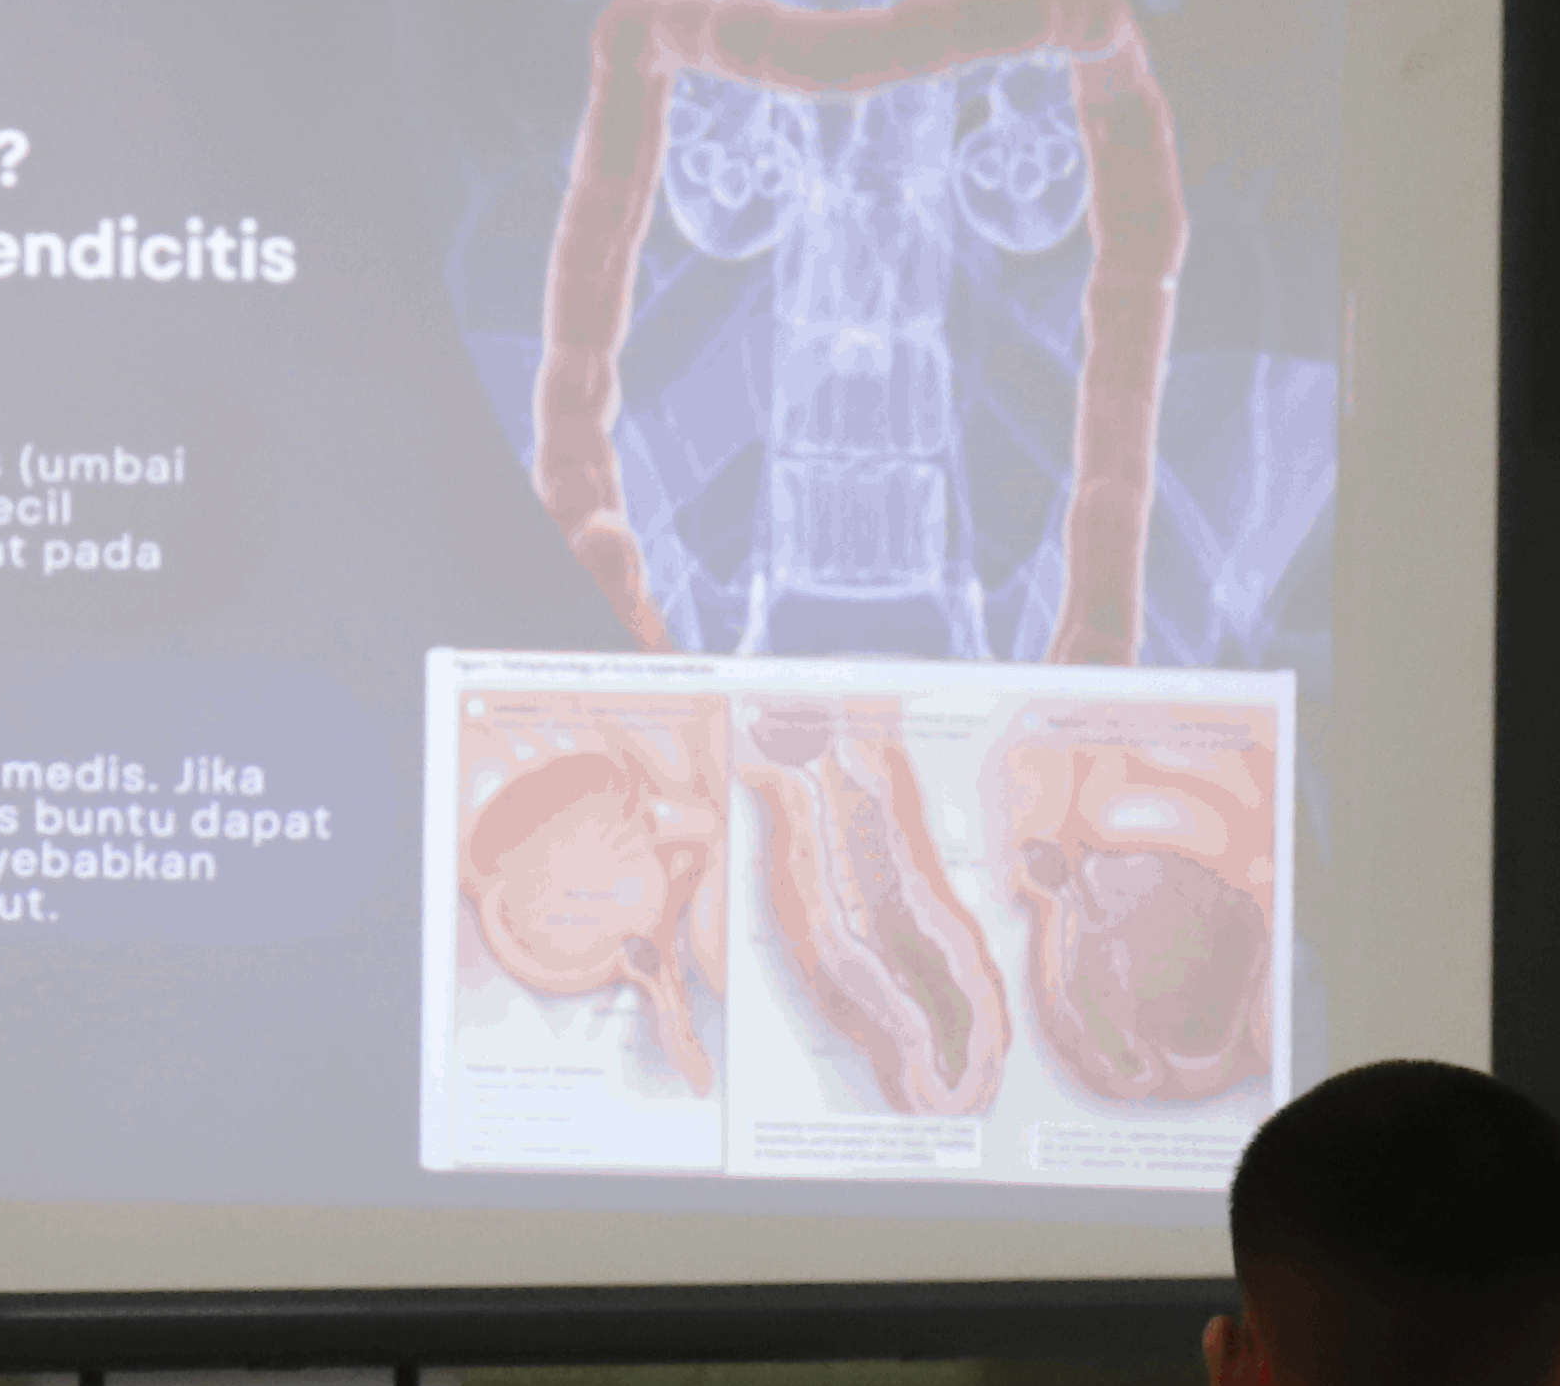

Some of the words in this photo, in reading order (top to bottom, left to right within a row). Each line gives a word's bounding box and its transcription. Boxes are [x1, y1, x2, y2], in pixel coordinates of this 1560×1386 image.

[18, 443, 185, 485] (umbai
[43, 533, 161, 575] pada
[1, 755, 159, 795] medis.
[173, 756, 263, 796] Jika
[35, 800, 174, 837] buntu
[190, 802, 331, 847] dapat
